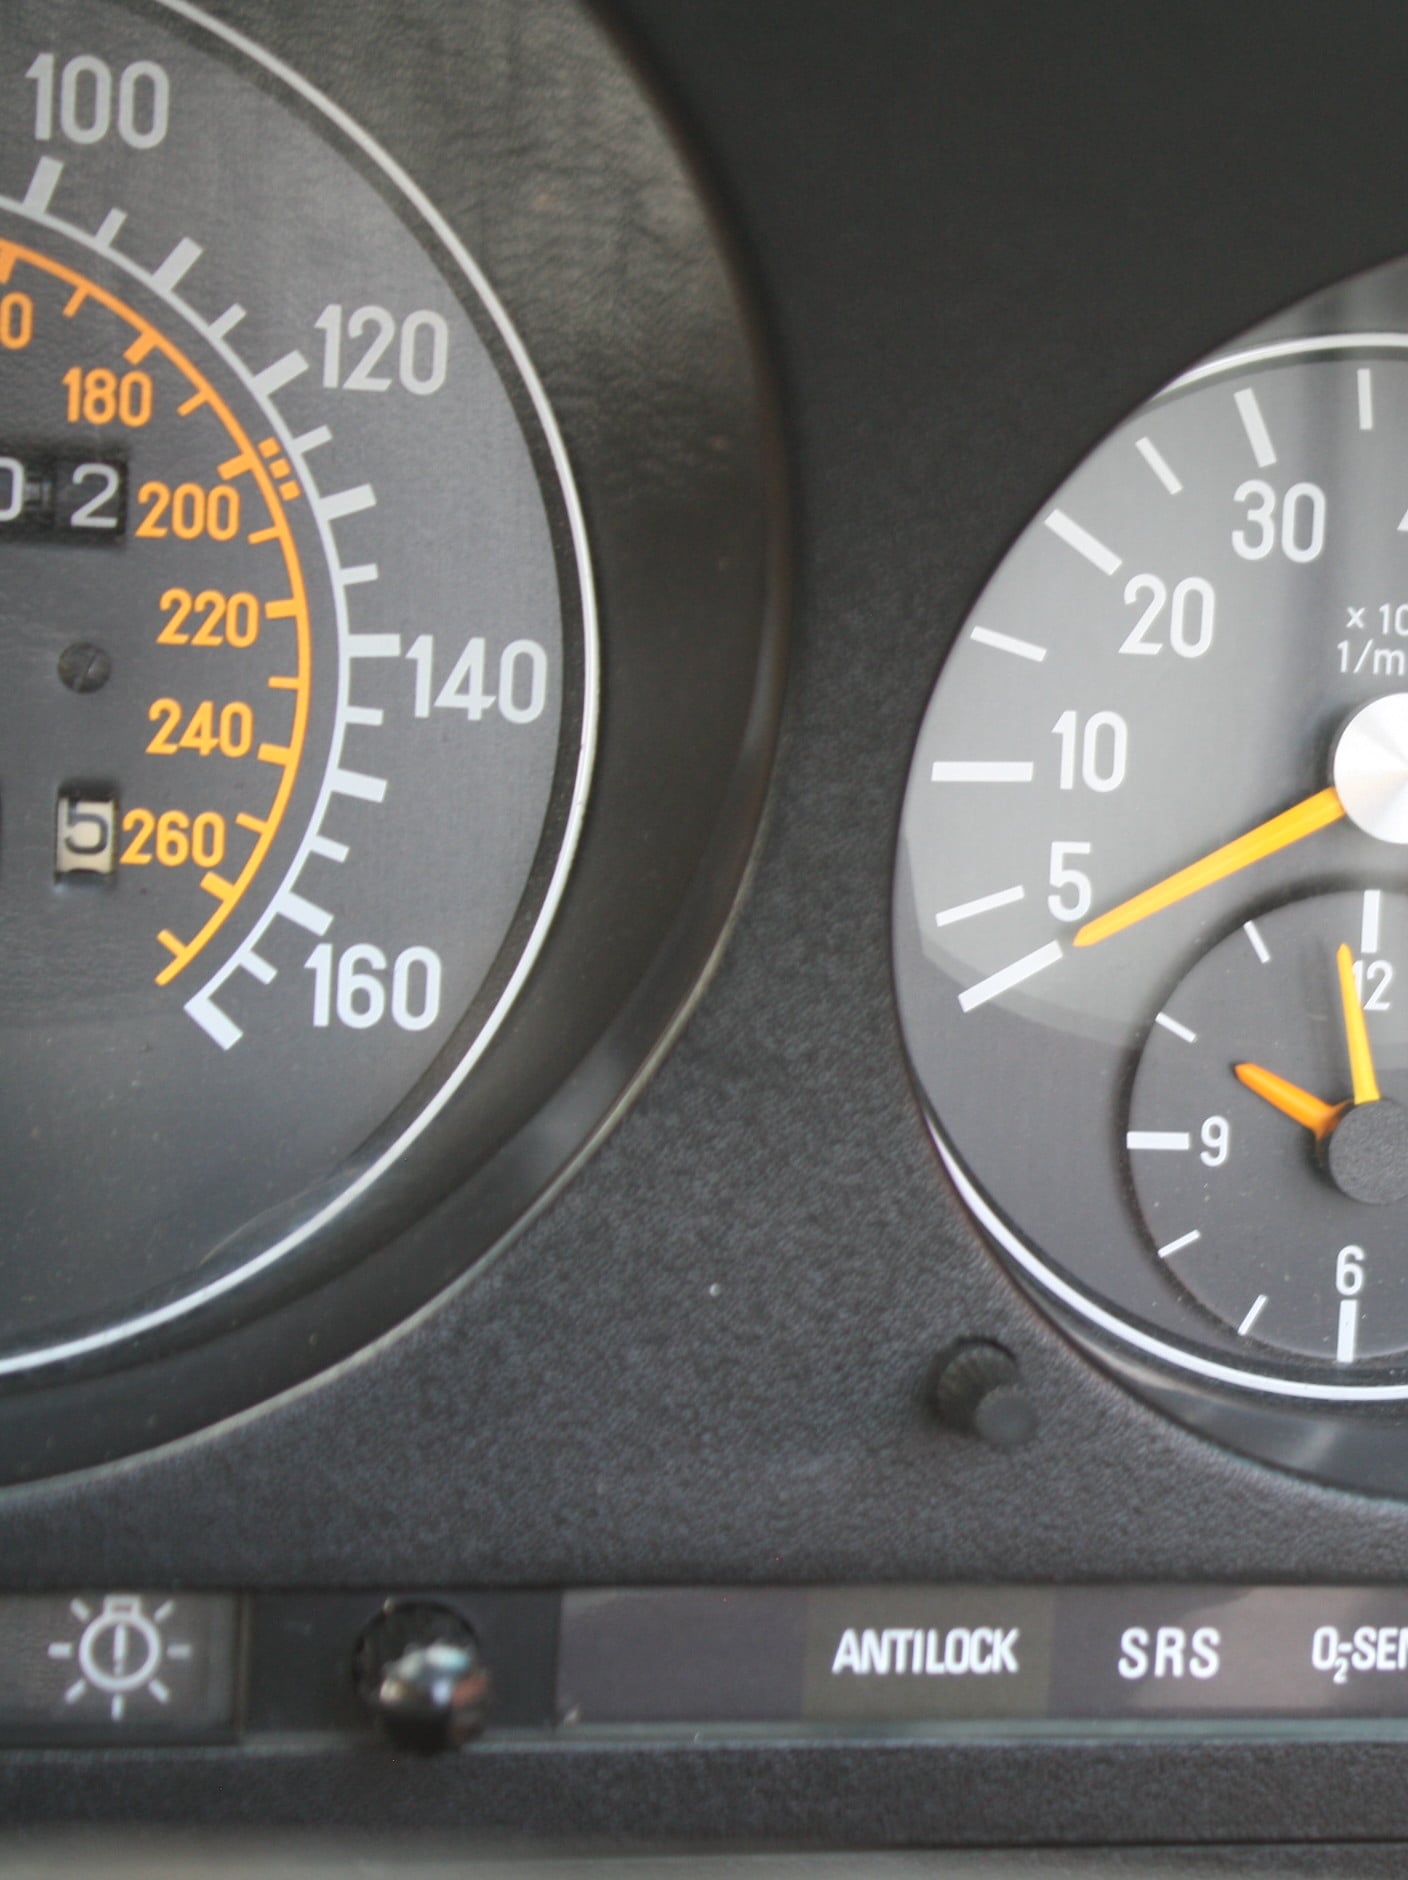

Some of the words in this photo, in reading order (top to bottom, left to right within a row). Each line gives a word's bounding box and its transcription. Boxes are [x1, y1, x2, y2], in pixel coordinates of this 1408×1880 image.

[26, 52, 170, 148] 100
[314, 303, 450, 395] 120
[62, 367, 152, 427] 180
[136, 481, 240, 540] 200
[1231, 480, 1326, 562] 30
[156, 587, 259, 648] 220
[1118, 574, 1215, 658] 20
[1346, 607, 1364, 629] x
[406, 635, 547, 722] 140
[146, 698, 253, 757] 240
[1051, 710, 1127, 792] 10
[120, 808, 224, 867] 260
[1047, 841, 1092, 921] 5
[304, 944, 442, 1030] 160
[1199, 1116, 1230, 1167] 9
[1335, 1245, 1365, 1296] 6
[831, 1628, 1018, 1674] ANTILOCK
[1118, 1627, 1221, 1679] SRS
